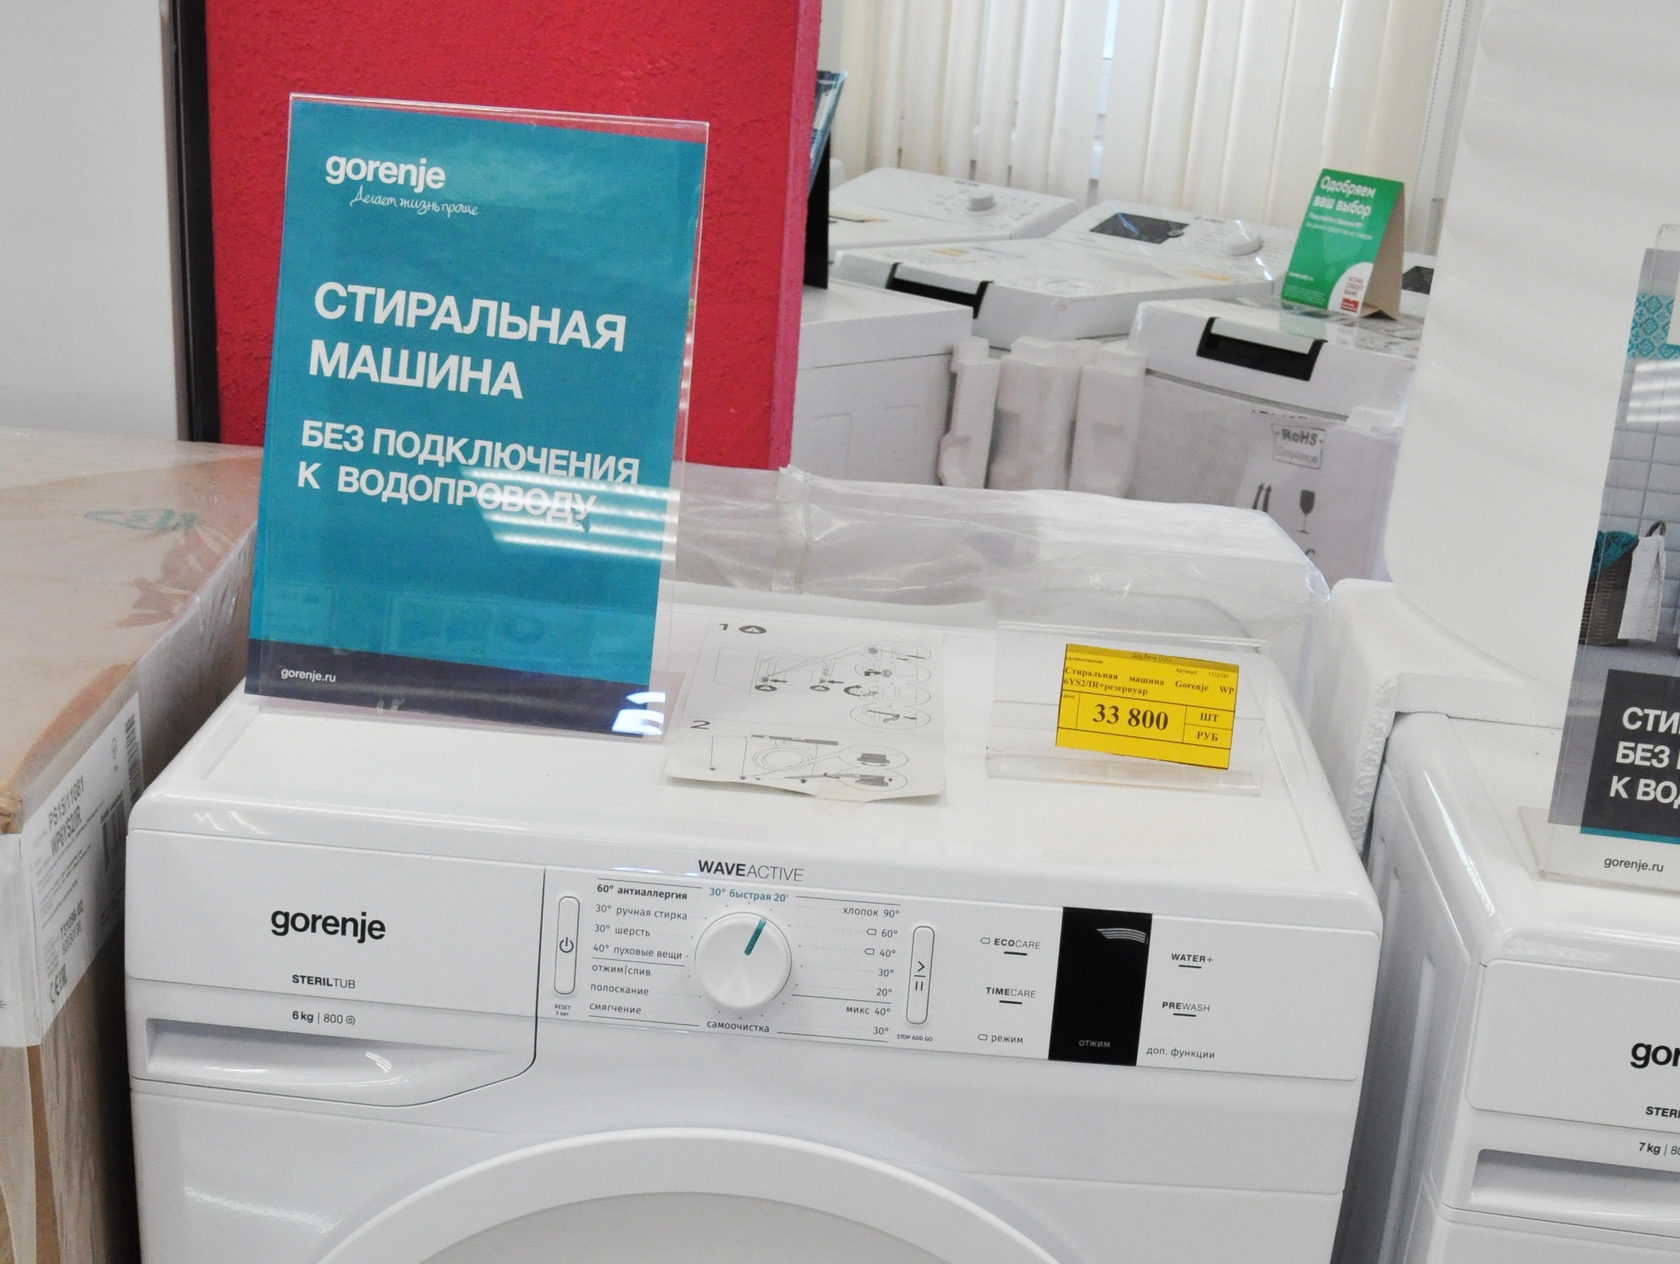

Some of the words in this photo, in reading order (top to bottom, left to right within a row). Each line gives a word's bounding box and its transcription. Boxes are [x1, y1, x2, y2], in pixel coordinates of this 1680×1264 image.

[325, 155, 446, 193] gorenje
[1320, 175, 1376, 199] Одобряем
[350, 185, 397, 207] Делает
[400, 197, 440, 215] жизнь
[442, 203, 478, 218] проще
[1313, 195, 1335, 210] ваш
[1335, 199, 1372, 219] выбор
[314, 281, 628, 353] СТИРАЛЬНАЯ
[308, 339, 523, 400] МАШИНА
[1282, 428, 1318, 446] RoHS
[301, 419, 364, 452] БЕЗ
[372, 427, 640, 486] ПОДКЛЮЧЕНИЯ
[297, 461, 321, 490] К
[337, 464, 597, 524] ВОДОПРОВОДУ
[280, 667, 337, 683] gorenje.ru
[1065, 666, 1118, 680] Стиральная
[1129, 675, 1164, 686] машина
[1175, 680, 1208, 693] Gorenje
[1219, 686, 1234, 695] WP
[1092, 703, 1120, 725] 33
[1128, 708, 1169, 730] 800
[1200, 712, 1220, 722] ШТ
[1622, 706, 1680, 735] СТИ
[690, 720, 710, 730] 2
[1197, 730, 1218, 742] РУБ
[1616, 741, 1670, 769] БЕЗ
[1609, 776, 1631, 799] К
[1636, 778, 1680, 809] ВО
[698, 859, 804, 882] WAVEACTIVE
[1604, 857, 1664, 872] gorenje.ru
[618, 886, 688, 900] антиаллергия
[730, 889, 771, 901] быстрая
[616, 906, 651, 916] ручная
[654, 910, 688, 920] стирка
[842, 907, 878, 916] хлопок
[270, 910, 386, 944] gorenje
[614, 926, 650, 937] шерсть
[994, 938, 1040, 950] ECOCARE
[614, 946, 654, 957] пуховые
[656, 950, 682, 960] вещи
[1171, 953, 1214, 964] WATER+
[292, 974, 356, 989] STERILTUB
[590, 984, 650, 996] полоскание
[986, 987, 1036, 999] TIMECARE
[590, 1002, 642, 1014] смягчение
[846, 1006, 870, 1014] микс
[1162, 1002, 1210, 1012] PREWASH
[292, 1010, 299, 1020] 6
[300, 1011, 314, 1024] kg
[324, 1014, 344, 1024] 800
[706, 1020, 770, 1032] самоочистка
[991, 1034, 1024, 1044] режим
[1078, 1039, 1111, 1048] отжим
[1146, 1047, 1168, 1057] доп.
[1170, 1047, 1216, 1059] функции
[1638, 1142, 1646, 1152] 7
[1646, 1142, 1661, 1156] kg
